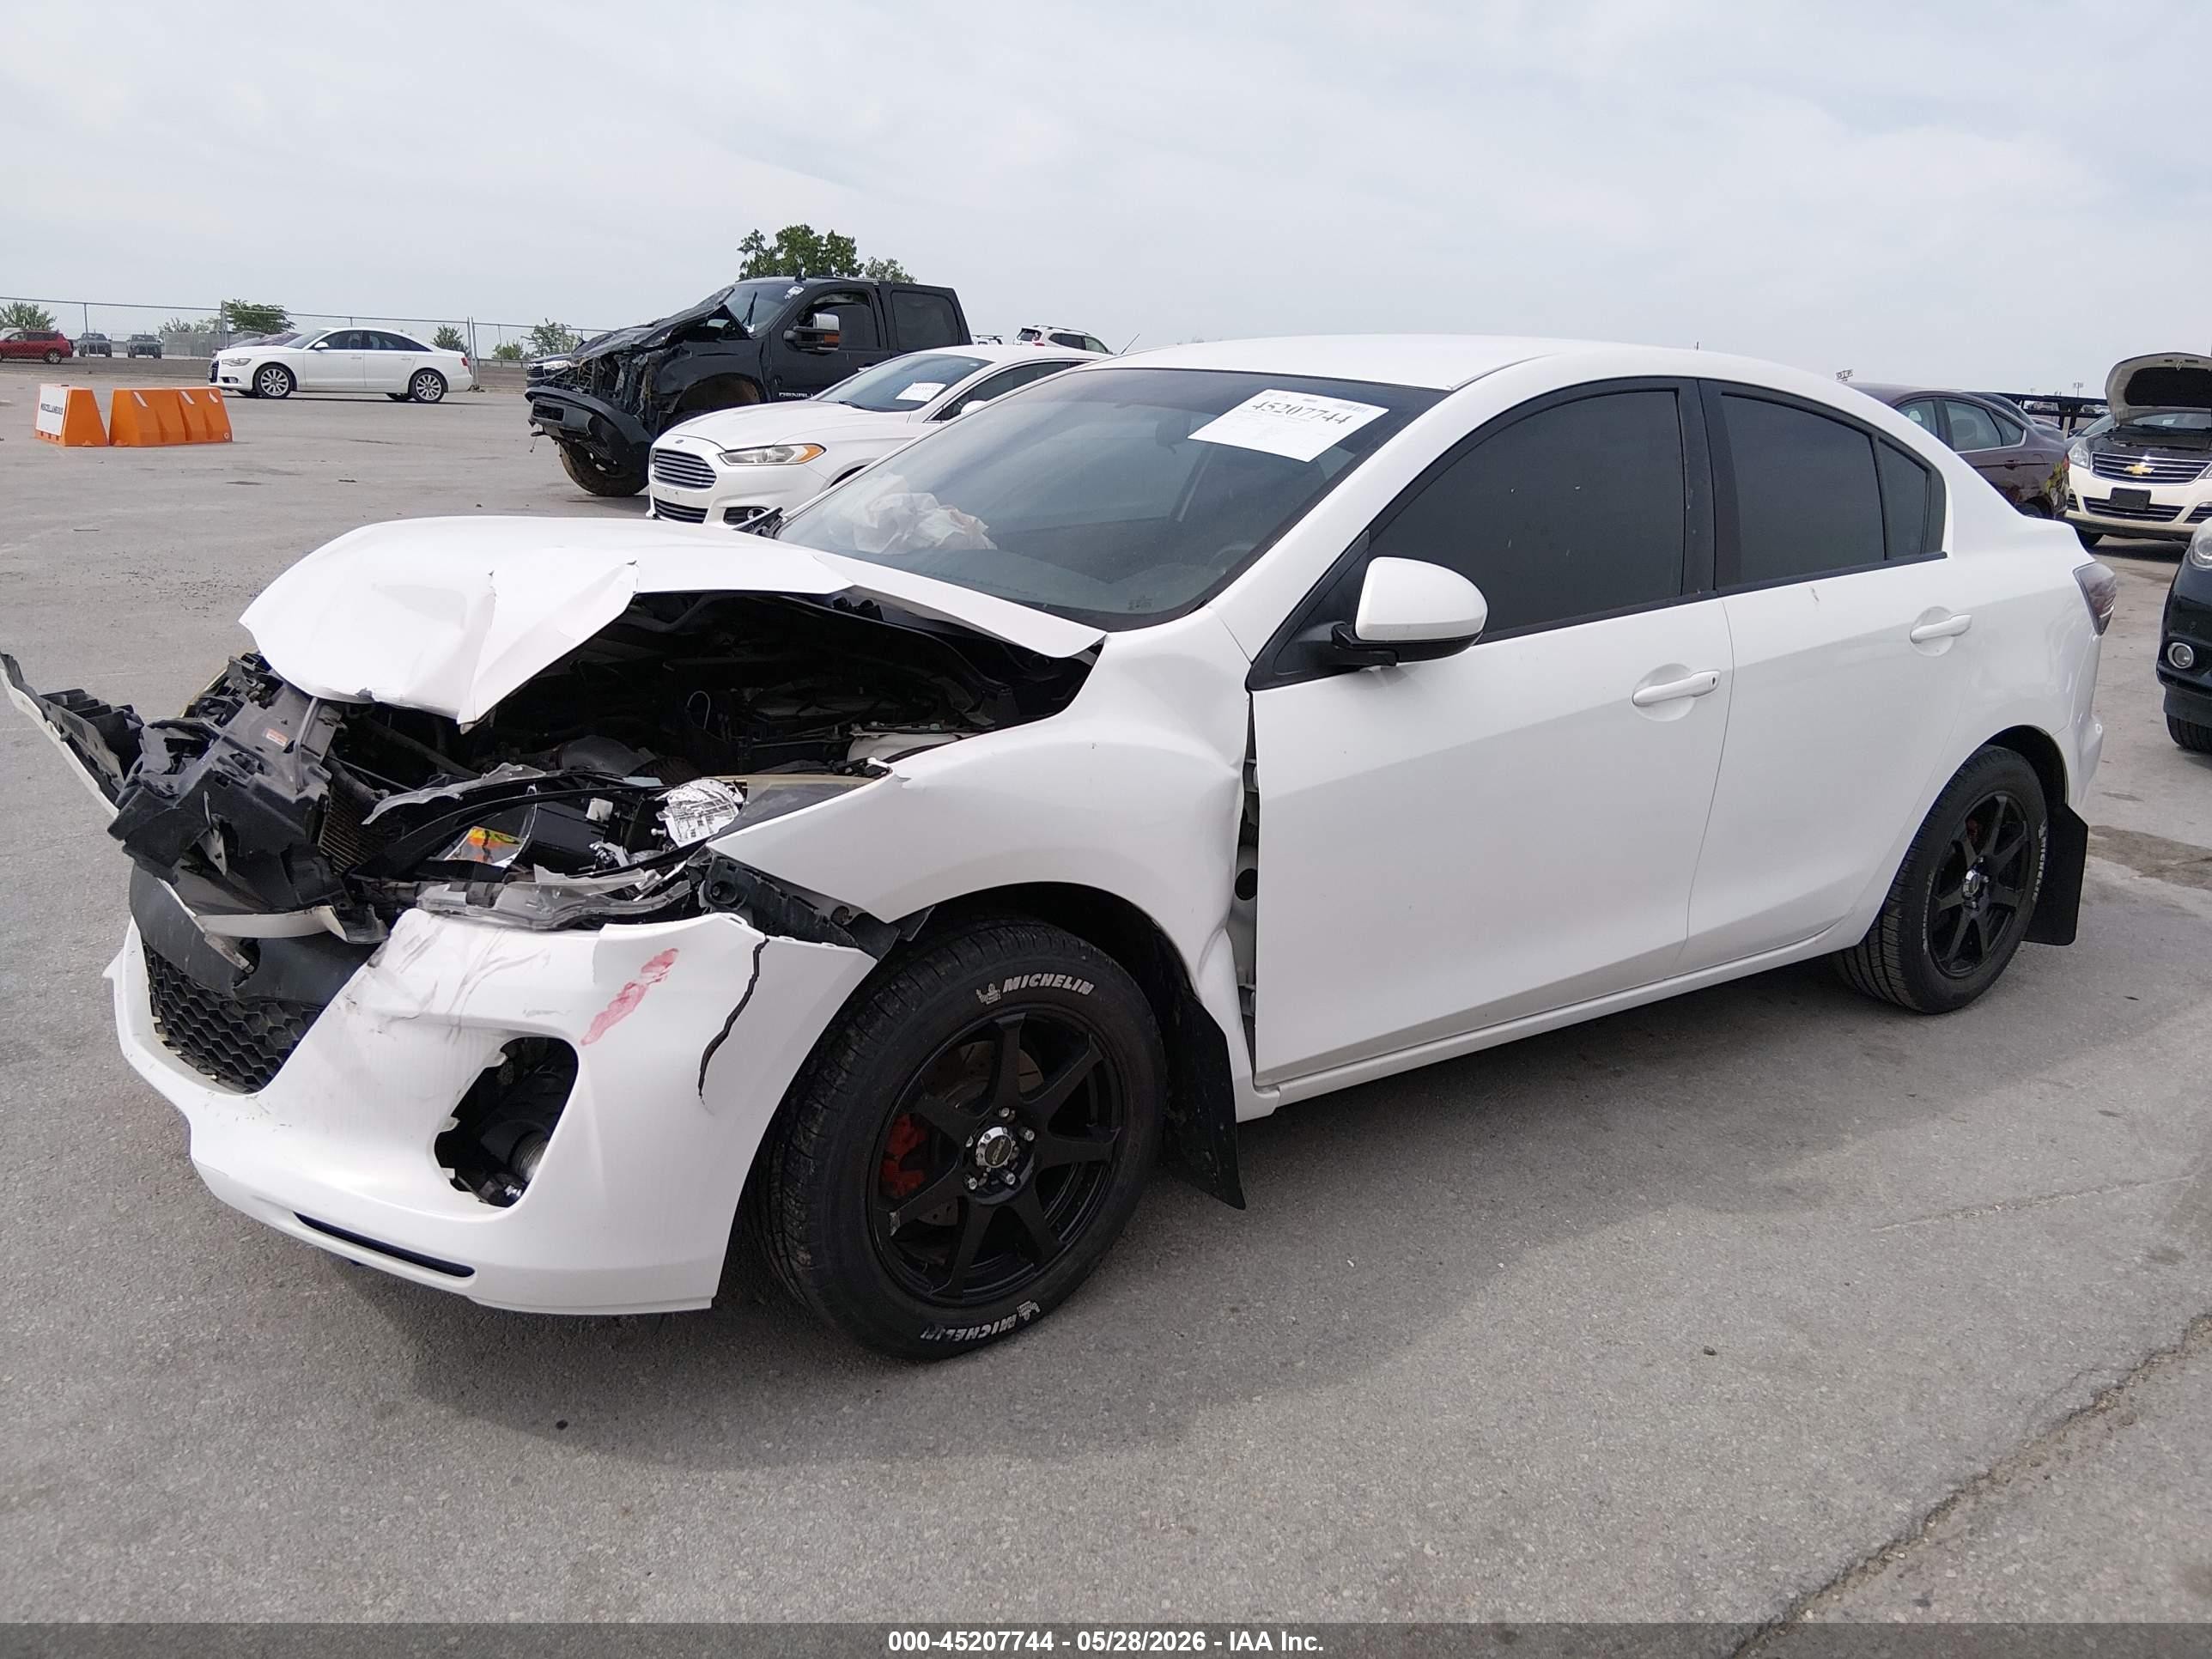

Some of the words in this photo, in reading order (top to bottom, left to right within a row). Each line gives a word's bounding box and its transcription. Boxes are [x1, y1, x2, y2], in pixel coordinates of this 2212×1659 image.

[1251, 400, 1353, 425] 45207744
[1002, 973, 1095, 996] MICHELIN
[920, 1314, 1018, 1341] MICHELIN
